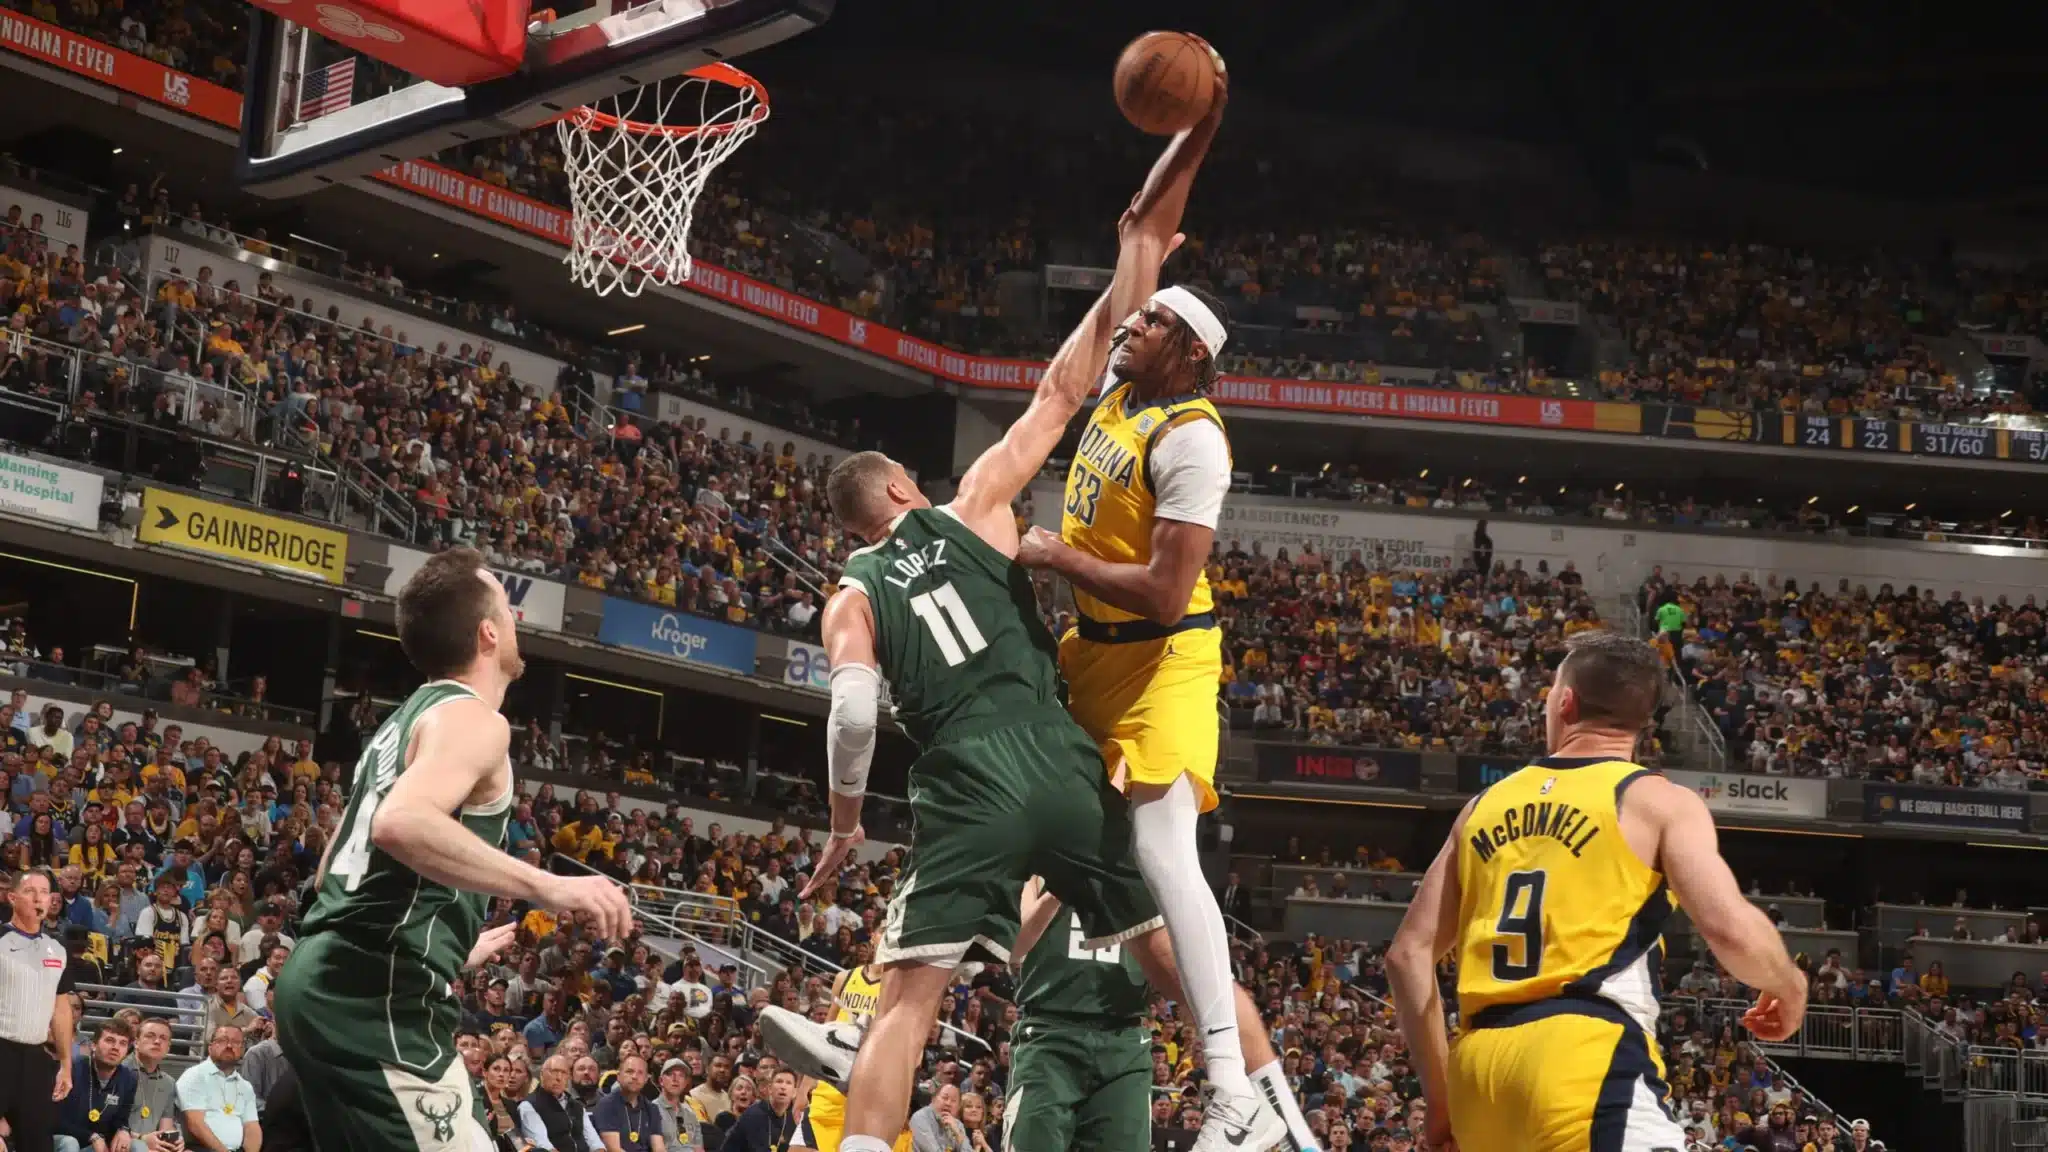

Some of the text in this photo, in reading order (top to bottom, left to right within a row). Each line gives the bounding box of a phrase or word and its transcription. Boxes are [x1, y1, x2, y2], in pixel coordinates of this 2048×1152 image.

[0, 14, 114, 76] NDIANA FEVER
[164, 72, 189, 94] US
[403, 160, 561, 235] PROVIDER OF GAINBRIDGE
[56, 208, 72, 229] 116
[743, 283, 784, 315] INDIANA
[787, 299, 819, 325] FEVER
[850, 317, 866, 337] US
[897, 338, 937, 368] OFFICIAL
[940, 353, 966, 376] FOOD
[968, 361, 1021, 384] SERVICE
[1279, 384, 1333, 405] INDIANA
[1337, 389, 1385, 410] PACERS
[1404, 395, 1456, 416] INDIANA
[1460, 399, 1499, 417] FEVER
[1540, 401, 1561, 417] US
[1806, 428, 1830, 445] 24
[1866, 421, 1886, 431] AST
[1920, 424, 1988, 438] FIELD GOALS
[1864, 432, 1888, 449] 22
[1925, 436, 1984, 455] 31/60
[0, 457, 58, 485] Manning
[14, 478, 74, 504] Hospital
[1066, 462, 1102, 528] 33
[187, 511, 337, 570] GAINBRIDGE
[885, 539, 947, 589] LOPEZ
[651, 613, 708, 658] Kroger
[909, 580, 989, 667] 11
[1728, 778, 1789, 801] slack
[1899, 799, 2024, 819] WE GROW BASKETBALL HERE
[1470, 801, 1600, 864] McCONNELL
[1491, 868, 1547, 983] 9
